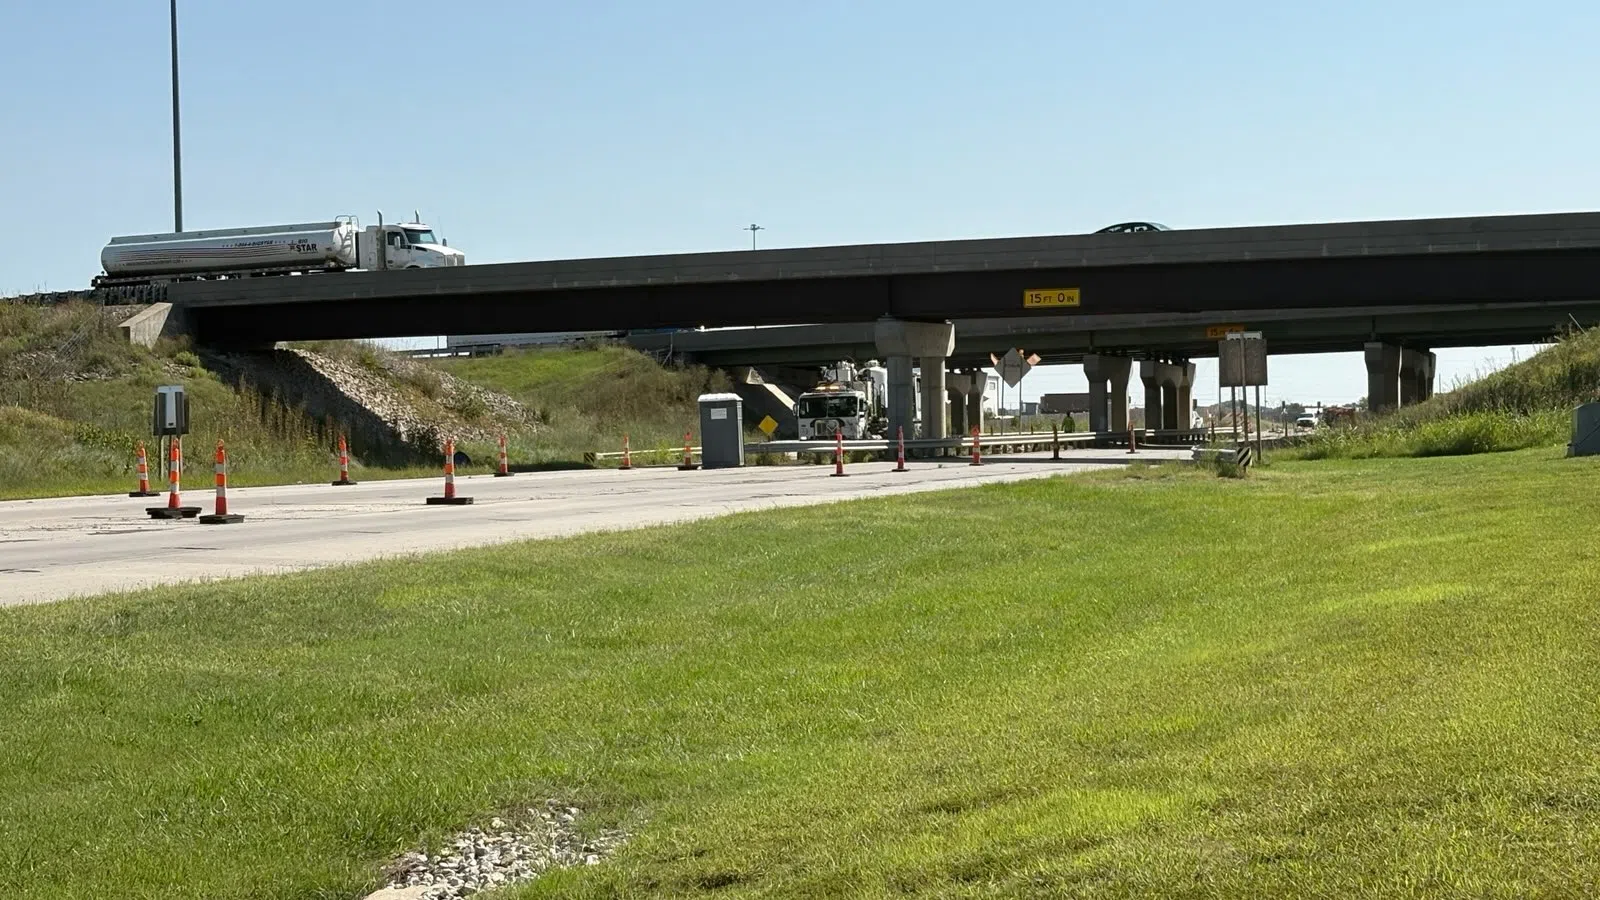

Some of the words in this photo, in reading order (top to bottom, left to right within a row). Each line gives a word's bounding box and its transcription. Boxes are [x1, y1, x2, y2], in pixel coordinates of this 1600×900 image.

[296, 244, 317, 252] STAR
[1030, 293, 1041, 304] 15
[1057, 292, 1065, 303] 0
